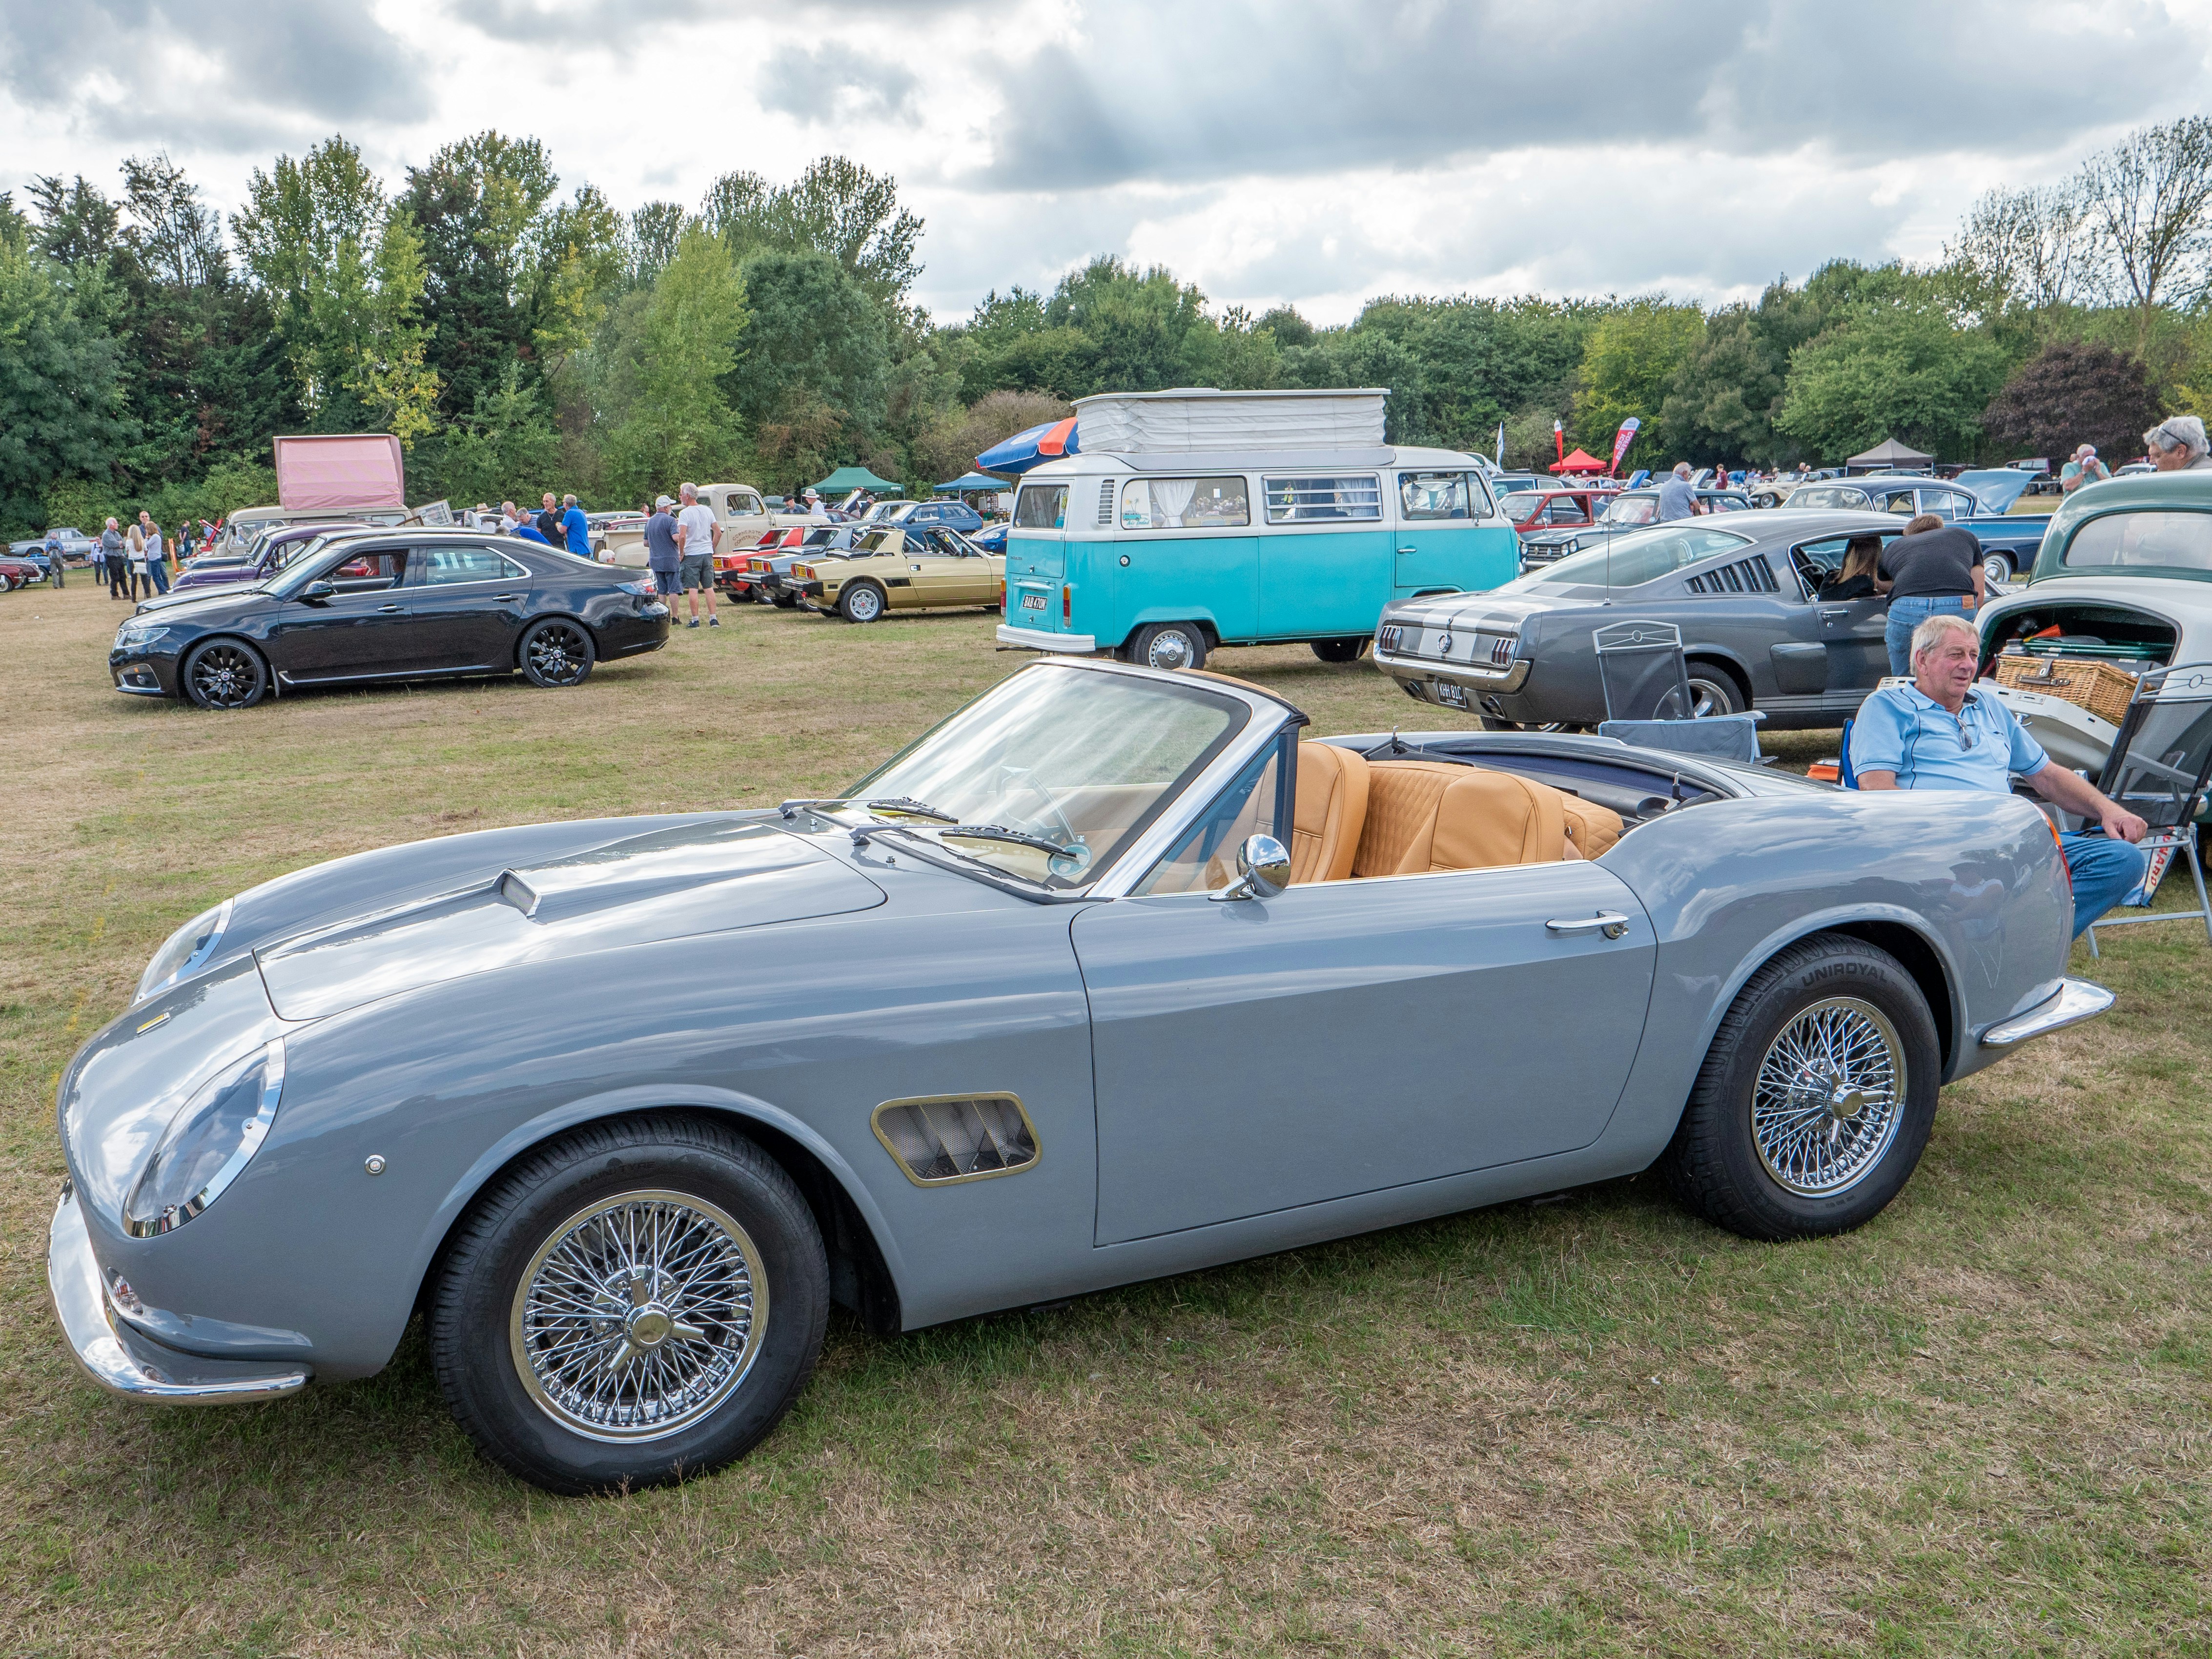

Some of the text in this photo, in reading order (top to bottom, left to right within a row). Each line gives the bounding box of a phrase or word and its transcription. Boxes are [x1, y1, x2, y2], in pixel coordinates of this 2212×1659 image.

[1024, 596, 1034, 608] BAB
[1439, 683, 1462, 700] KHH 81C
[1801, 963, 1889, 987] UNIROYAL
[710, 1146, 741, 1162] TECHNOLOGY
[617, 1160, 656, 1173] TYRE
